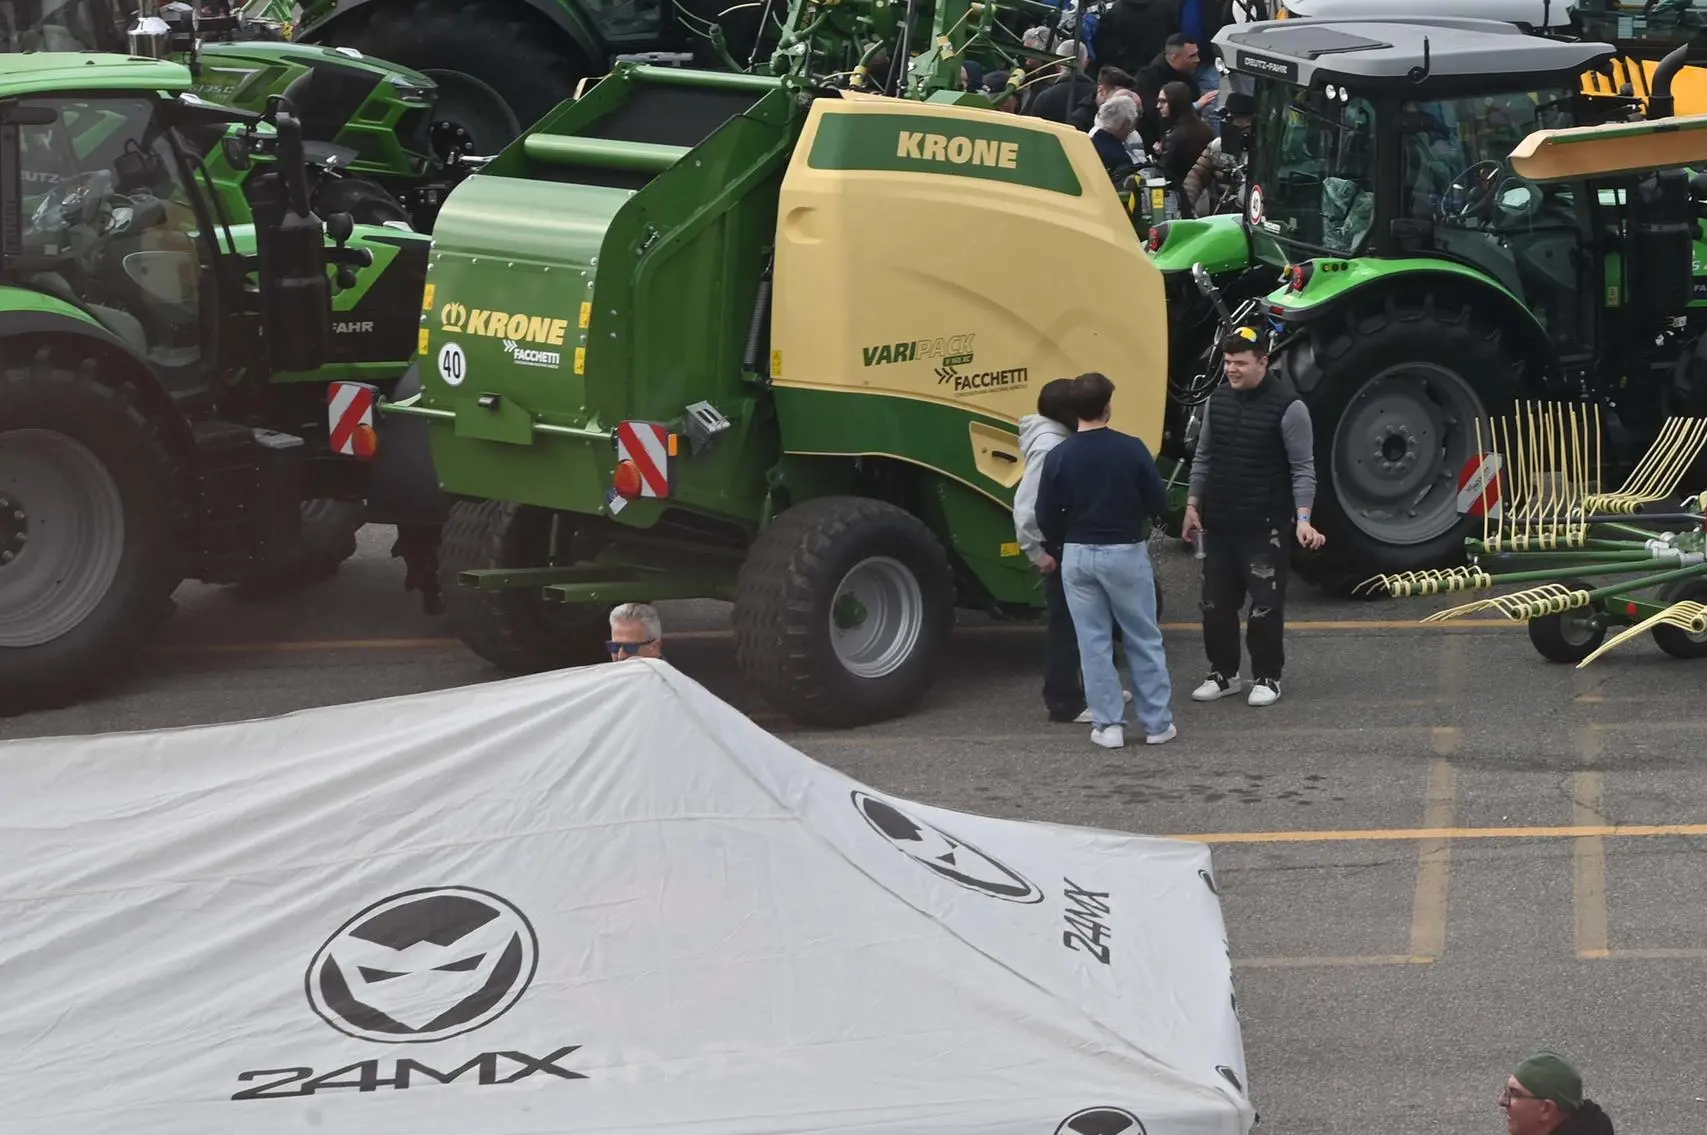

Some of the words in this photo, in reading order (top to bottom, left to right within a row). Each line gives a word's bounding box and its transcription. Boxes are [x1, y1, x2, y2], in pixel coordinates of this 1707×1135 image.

[897, 130, 1019, 169] KRONE
[466, 309, 568, 346] KRONE
[443, 350, 461, 379] 40
[513, 348, 560, 365] FACCHETTI
[862, 333, 976, 367] VARIPACK
[954, 367, 1028, 391] FACCHETTI
[1063, 876, 1111, 965] 24MX
[231, 1045, 591, 1101] 24MX
